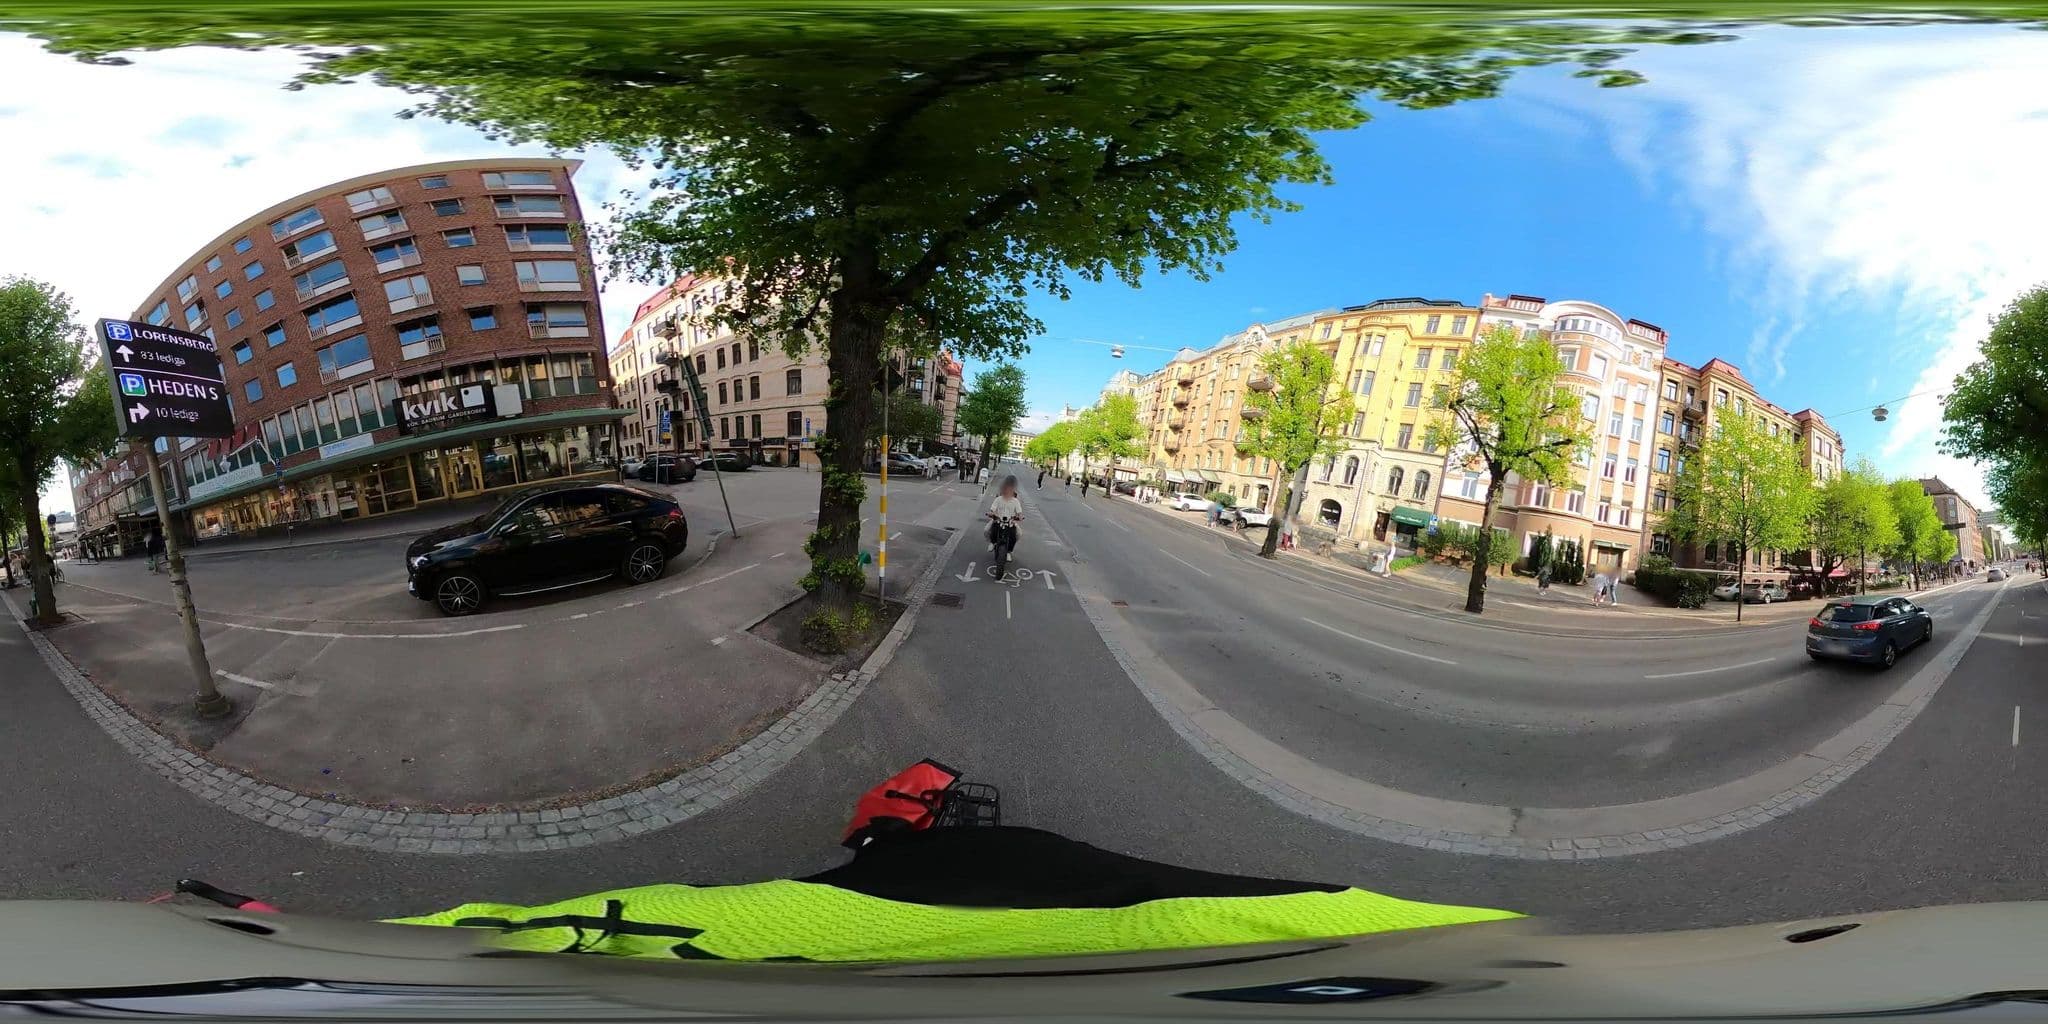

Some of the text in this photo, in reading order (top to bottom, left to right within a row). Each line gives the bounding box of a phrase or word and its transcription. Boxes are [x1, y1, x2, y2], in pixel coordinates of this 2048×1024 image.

[133, 328, 215, 353] LORENSBERG
[155, 352, 186, 367] lediga
[148, 378, 207, 400] HEDEN
[208, 387, 219, 401] S
[155, 407, 199, 422] 10 lediga
[402, 391, 459, 420] kvik
